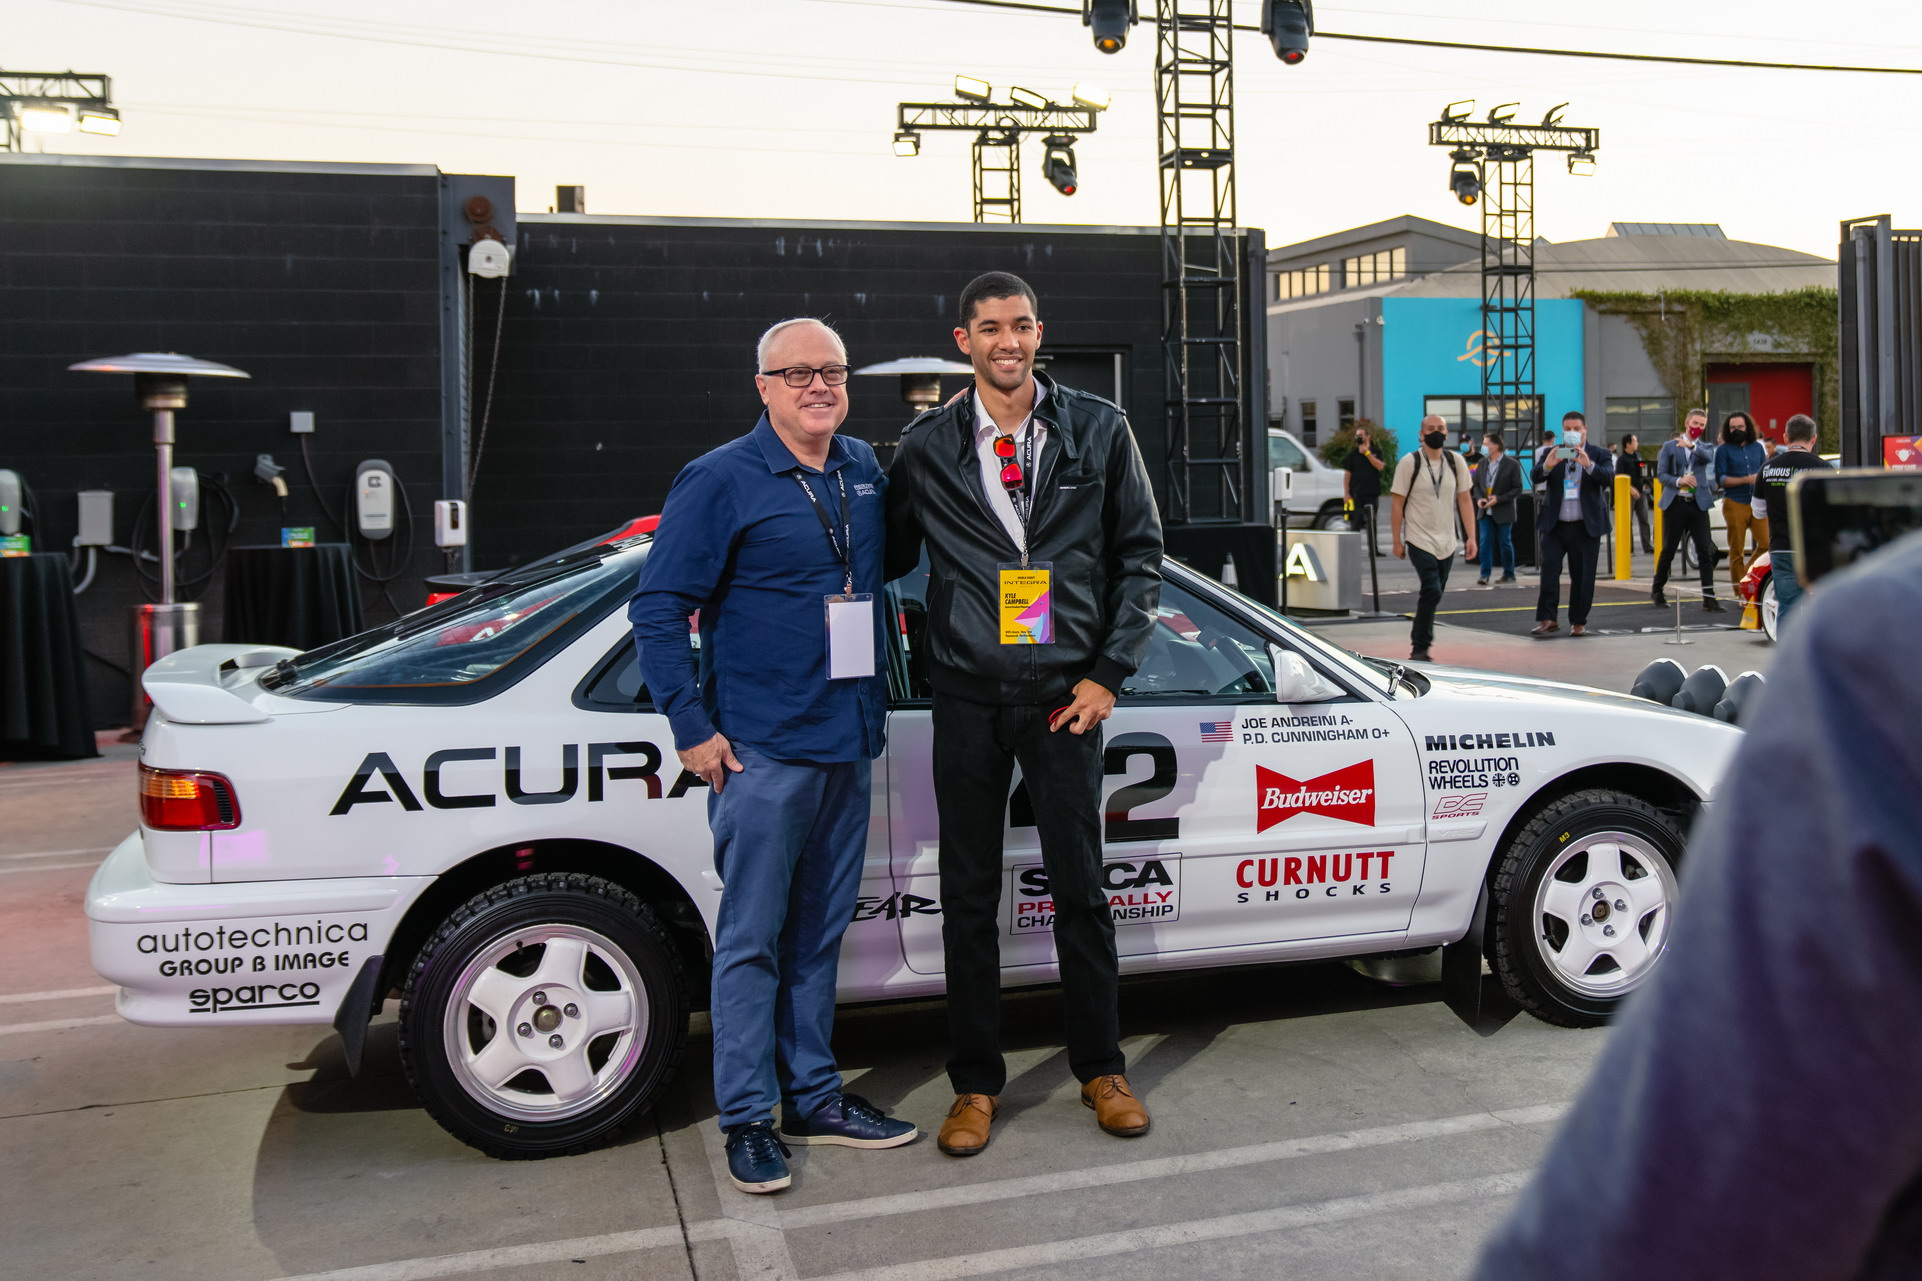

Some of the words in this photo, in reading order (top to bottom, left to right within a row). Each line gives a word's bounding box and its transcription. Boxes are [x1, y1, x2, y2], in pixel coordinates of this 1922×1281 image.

[1763, 467, 1791, 478] FURIOUS
[800, 480, 816, 502] ACURA
[1241, 717, 1268, 729] JOE
[1271, 715, 1337, 729] ANDREINI
[1340, 715, 1354, 726] A-
[1243, 733, 1268, 745] P.D.
[1271, 728, 1369, 743] CUNNINGHAM
[1424, 731, 1556, 751] MICHELIN
[1428, 757, 1519, 774] REVOLUTION
[1428, 774, 1489, 790] WHEELS
[1260, 785, 1373, 809] Budweiser
[1433, 792, 1488, 814] DC
[1431, 811, 1480, 820] SPORTS
[1559, 832, 1570, 843] M3
[1019, 860, 1174, 897] SCA
[1236, 851, 1395, 889] CURNUTT
[1018, 901, 1056, 915] PR
[1109, 890, 1174, 907] ALLY
[1237, 883, 1391, 904] SHOCKS
[1017, 904, 1174, 928] CHANSHIP
[136, 919, 368, 954] autotechnica
[159, 956, 244, 977] GROUP
[252, 955, 266, 973] B
[274, 950, 350, 972] IMAGE
[189, 981, 320, 1013] sparco
